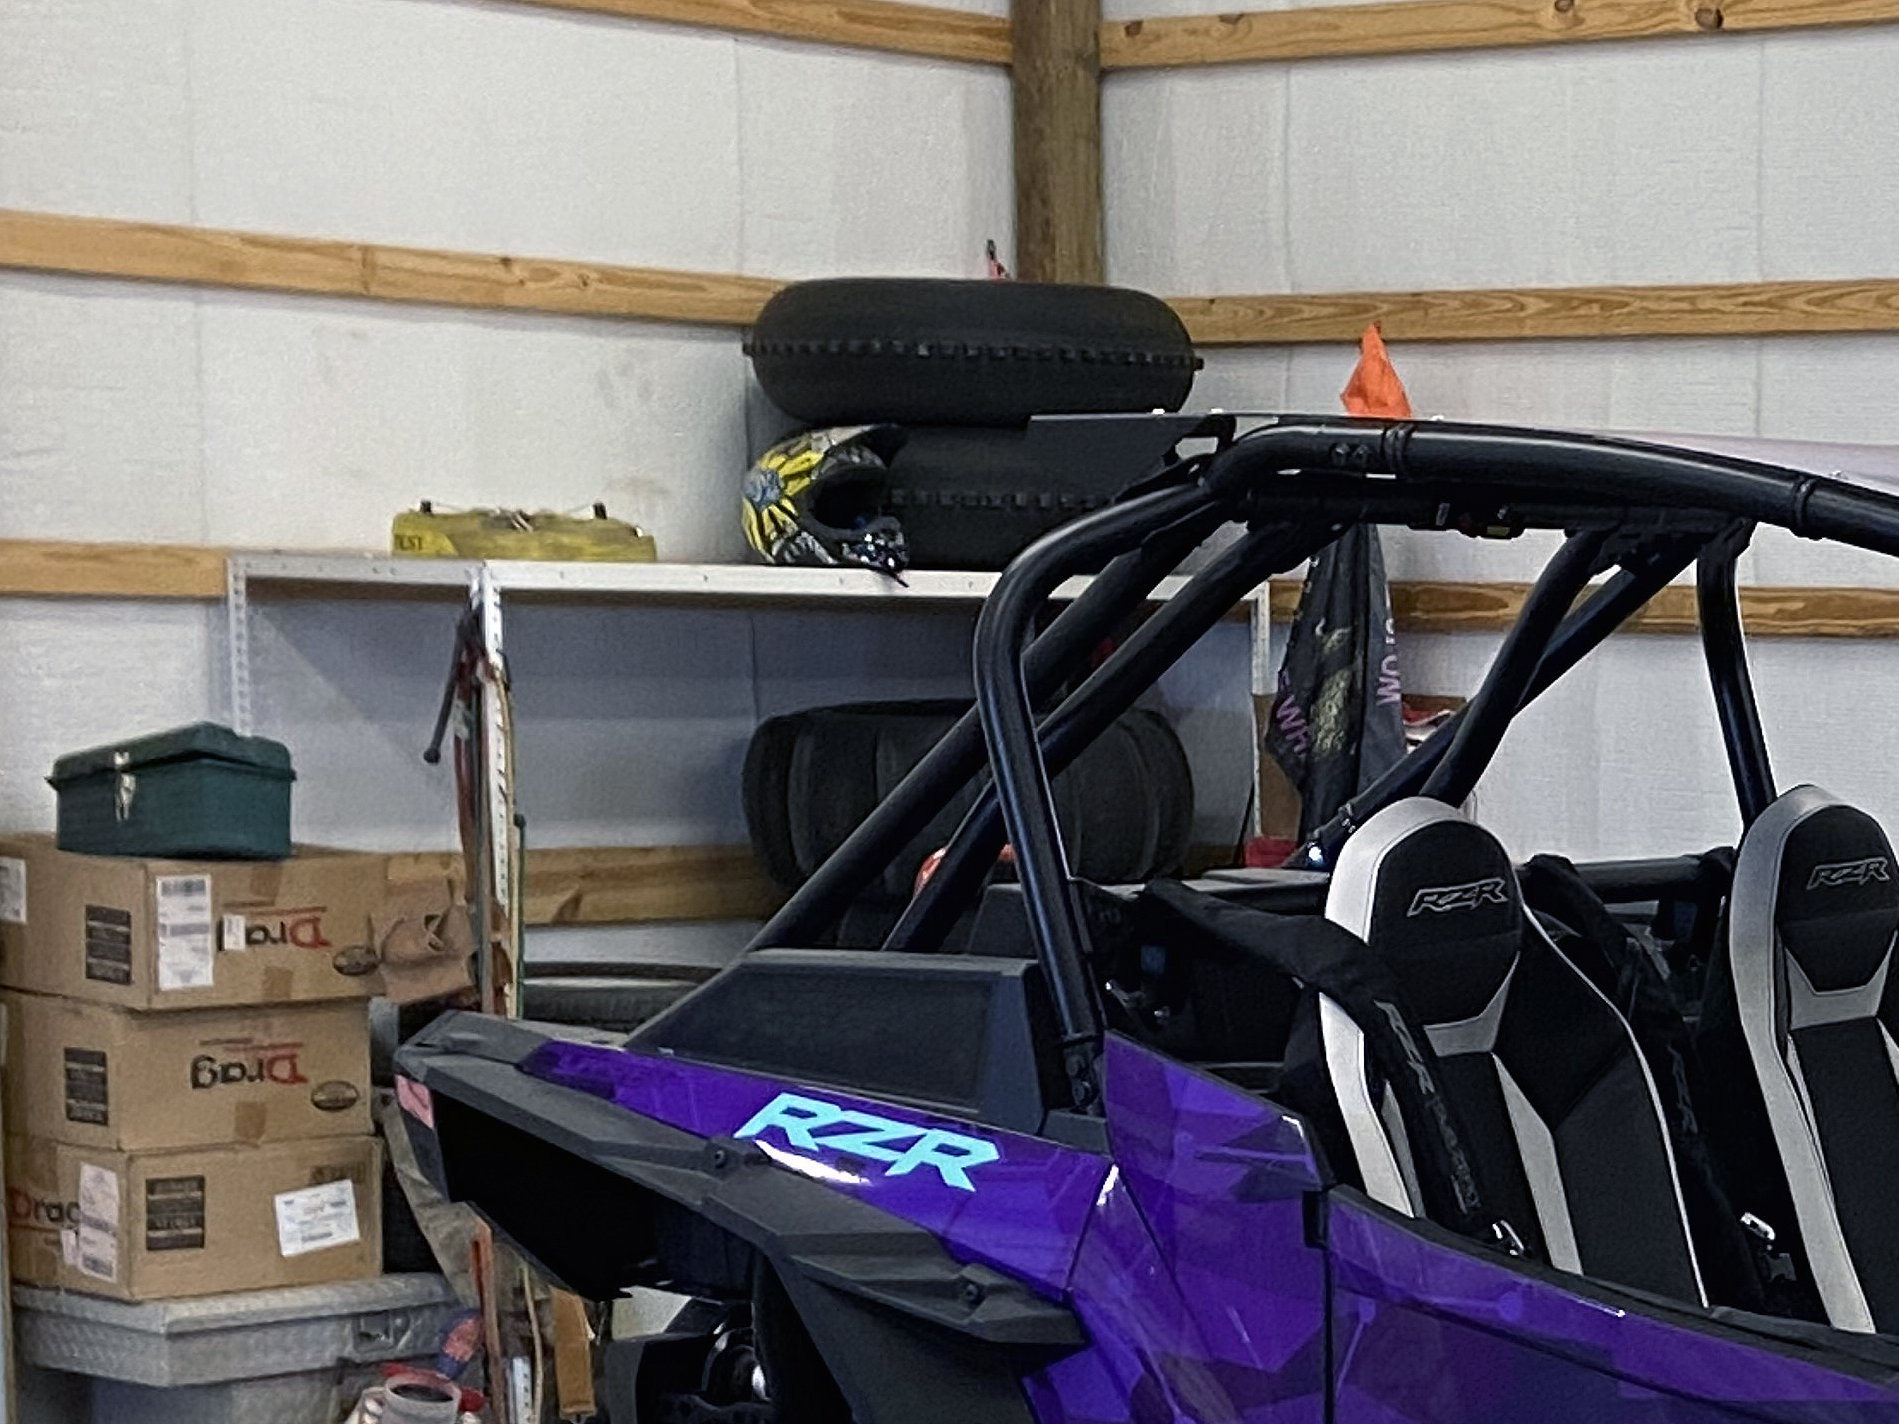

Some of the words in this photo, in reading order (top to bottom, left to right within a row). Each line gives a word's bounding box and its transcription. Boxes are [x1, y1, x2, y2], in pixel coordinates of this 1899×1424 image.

[216, 916, 333, 952] Dra
[190, 1054, 308, 1090] Drag
[733, 1092, 1000, 1192] RZR
